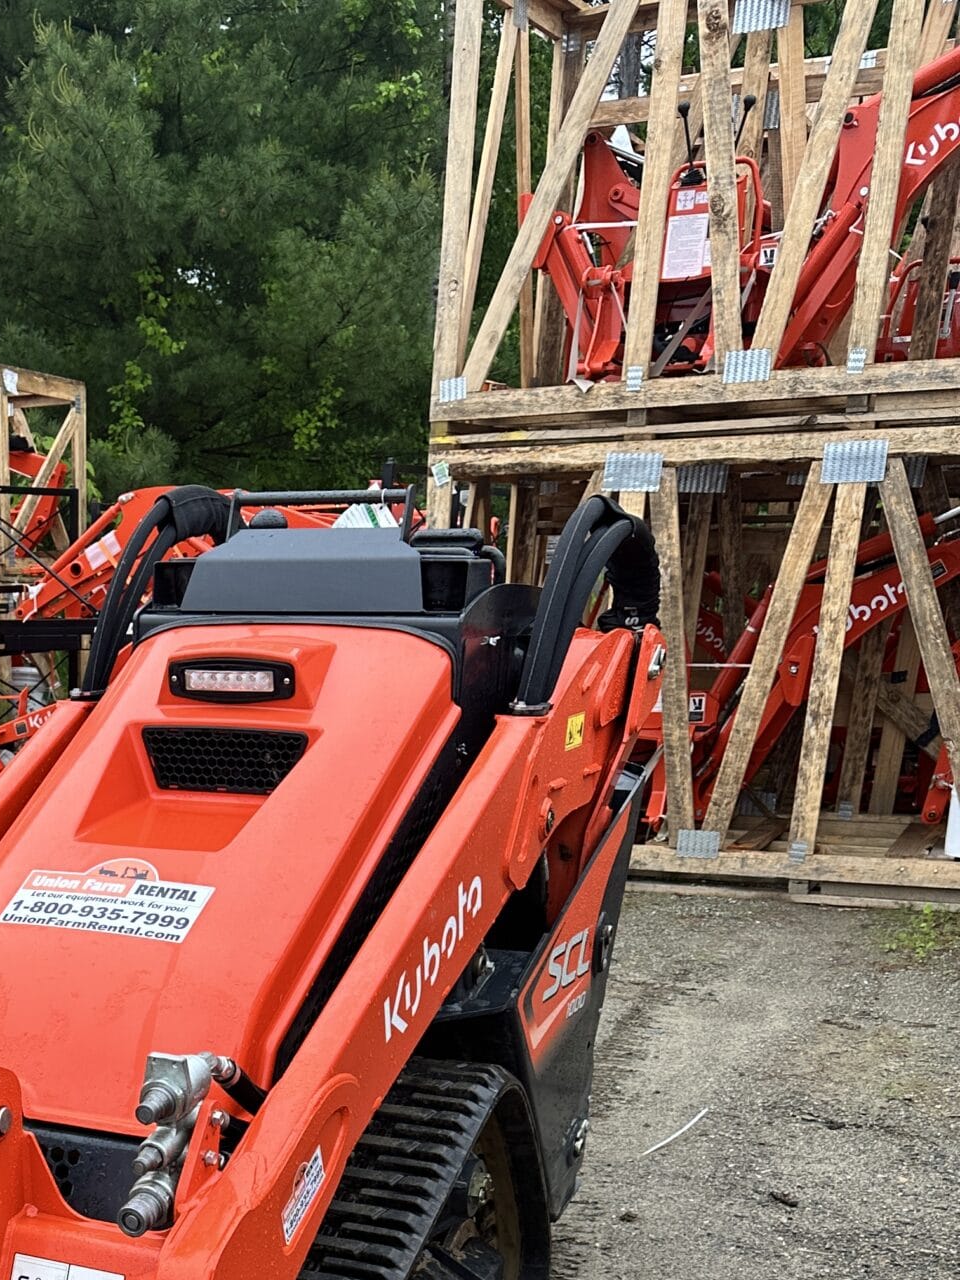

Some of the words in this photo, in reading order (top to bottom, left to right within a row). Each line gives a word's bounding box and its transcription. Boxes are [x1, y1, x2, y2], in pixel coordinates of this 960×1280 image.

[31, 890, 45, 898] Let
[65, 893, 118, 905] equipment
[120, 898, 146, 908] work
[147, 901, 163, 910] for
[165, 904, 188, 913] you!
[32, 875, 81, 890] Union
[82, 878, 126, 894] Farm
[134, 883, 197, 903] RENTAL
[2, 913, 181, 942] UnionFarmRental.com
[12, 899, 190, 931] 1-800-935-7999
[383, 875, 483, 1044] Kubota
[542, 926, 590, 1004] SCL
